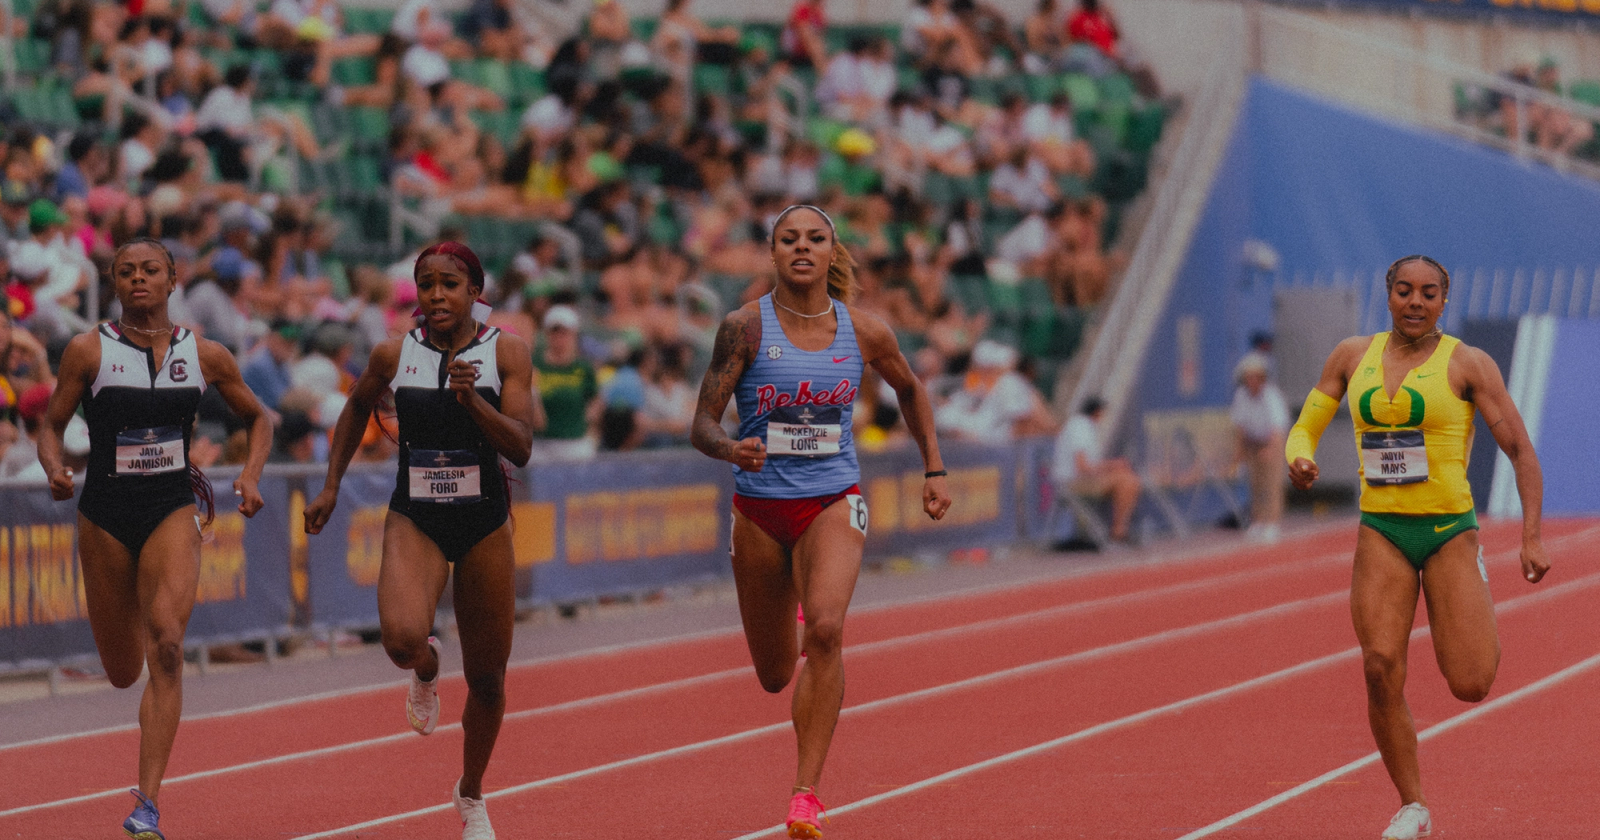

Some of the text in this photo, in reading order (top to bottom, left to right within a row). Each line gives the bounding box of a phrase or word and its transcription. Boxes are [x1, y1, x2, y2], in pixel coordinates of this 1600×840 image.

[767, 346, 782, 359] SEC
[756, 379, 858, 416] Rebels
[783, 427, 828, 438] MCKENZIE
[791, 439, 818, 451] LONG
[139, 446, 164, 457] JAYLA
[1380, 451, 1405, 461] JADYN
[127, 455, 174, 470] JAMISON
[422, 470, 465, 480] JAMEESIA
[1381, 463, 1407, 475] MAYS
[430, 482, 458, 494] FORD
[856, 497, 866, 530] 6
